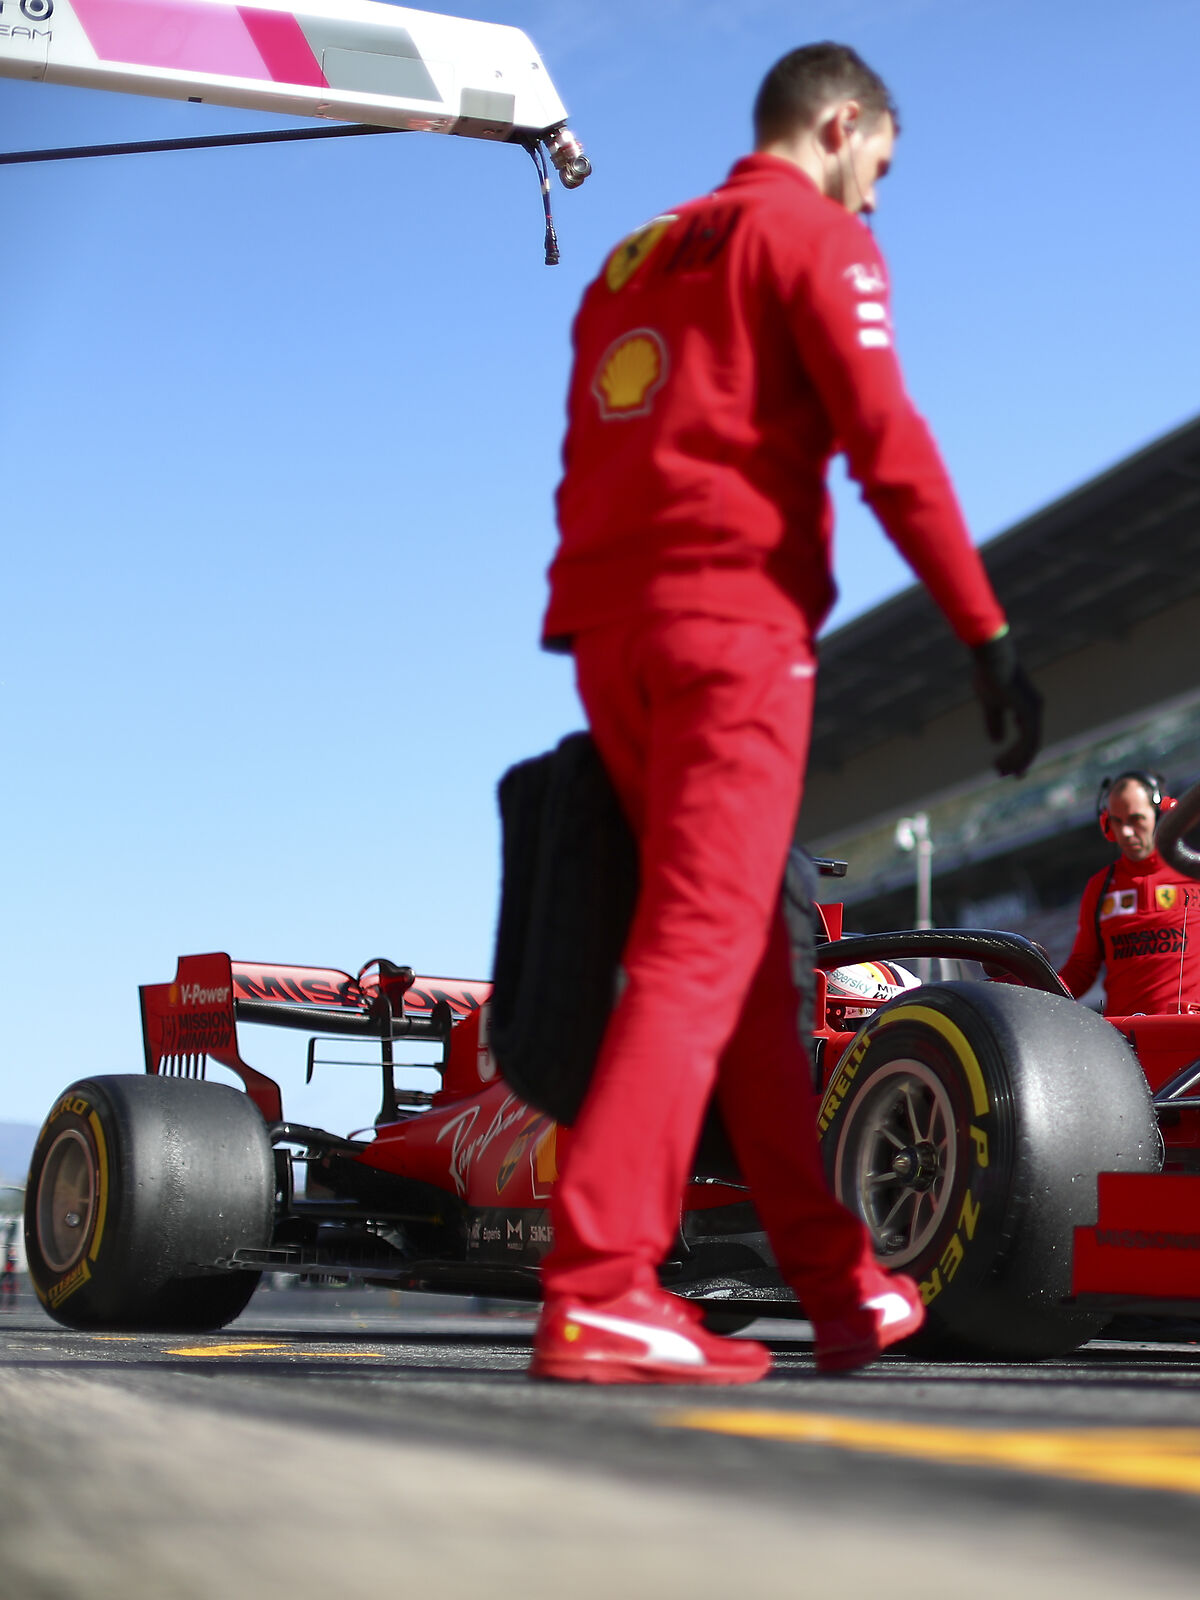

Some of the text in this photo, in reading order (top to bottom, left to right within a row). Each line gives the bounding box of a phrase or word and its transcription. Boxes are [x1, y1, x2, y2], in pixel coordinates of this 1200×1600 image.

[1110, 928, 1188, 947] MISSION
[1113, 941, 1189, 961] WINNOW
[180, 984, 231, 1006] V-Power
[232, 973, 481, 1013] MISSON
[178, 1011, 232, 1032] MISSION
[176, 1030, 233, 1051] WINNOW
